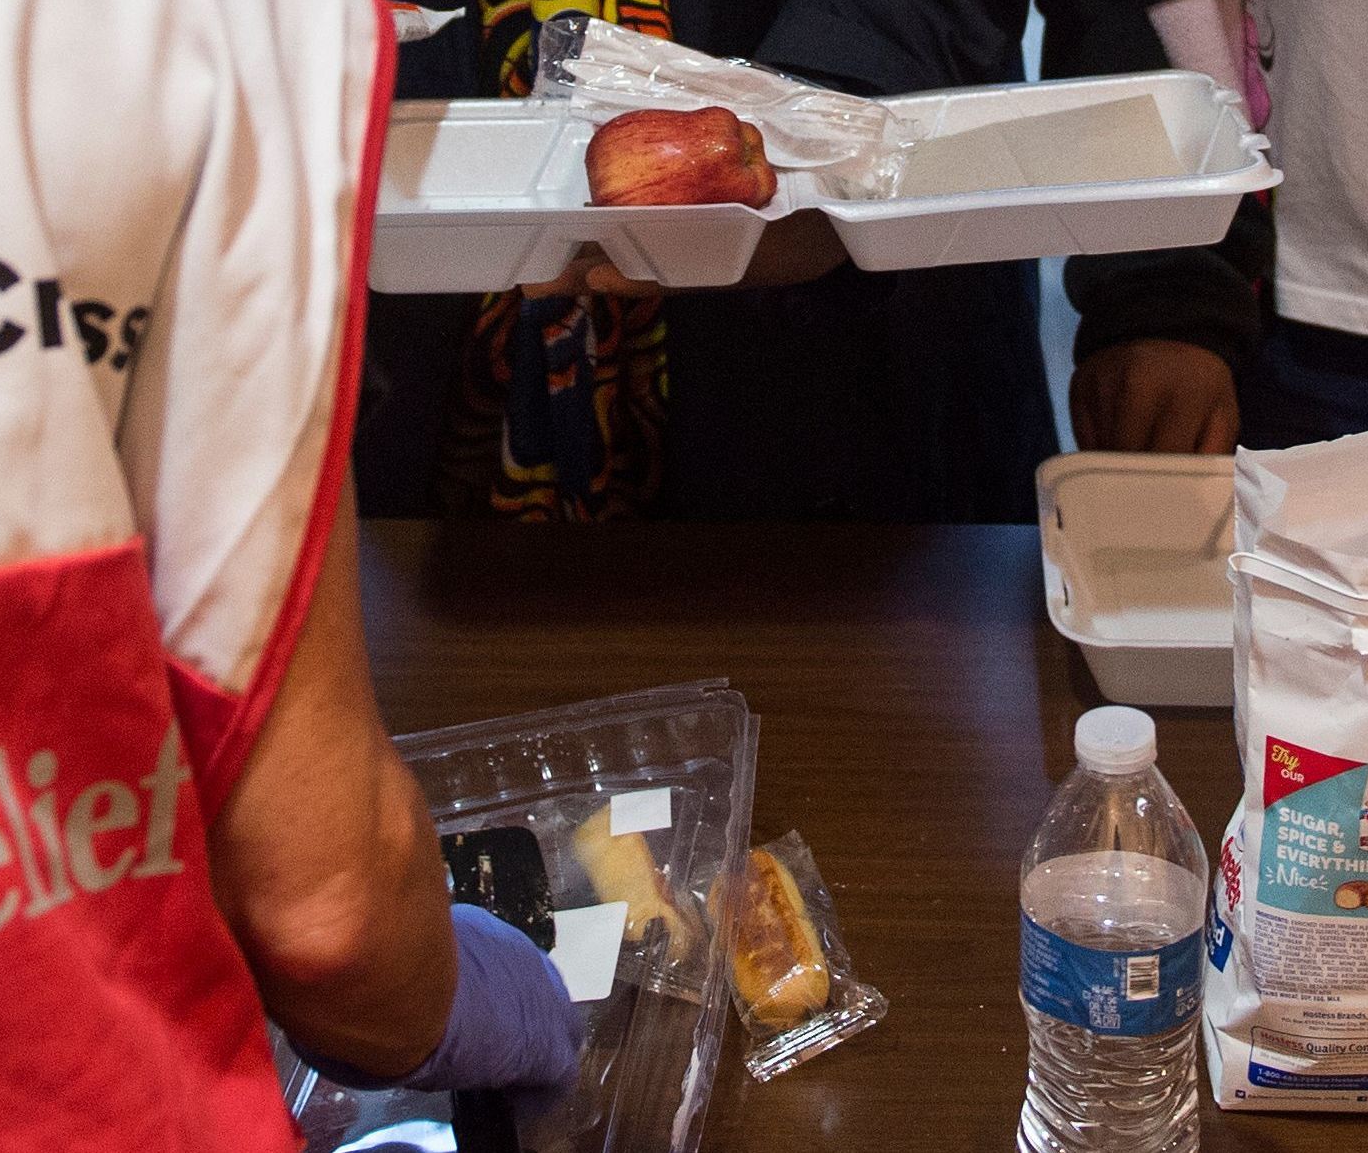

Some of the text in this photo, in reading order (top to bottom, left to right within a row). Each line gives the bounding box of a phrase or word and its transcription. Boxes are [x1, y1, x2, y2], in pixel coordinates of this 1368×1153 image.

[1271, 745, 1300, 770] Try
[1280, 768, 1305, 784] OUR
[1278, 807, 1345, 838] SUGAR,
[1277, 827, 1328, 852] SPICE
[1276, 863, 1320, 889] Nice
[1303, 1011, 1336, 1020] Hostess
[1337, 1012, 1368, 1021] Brands,
[1306, 1042, 1347, 1055] Quality
